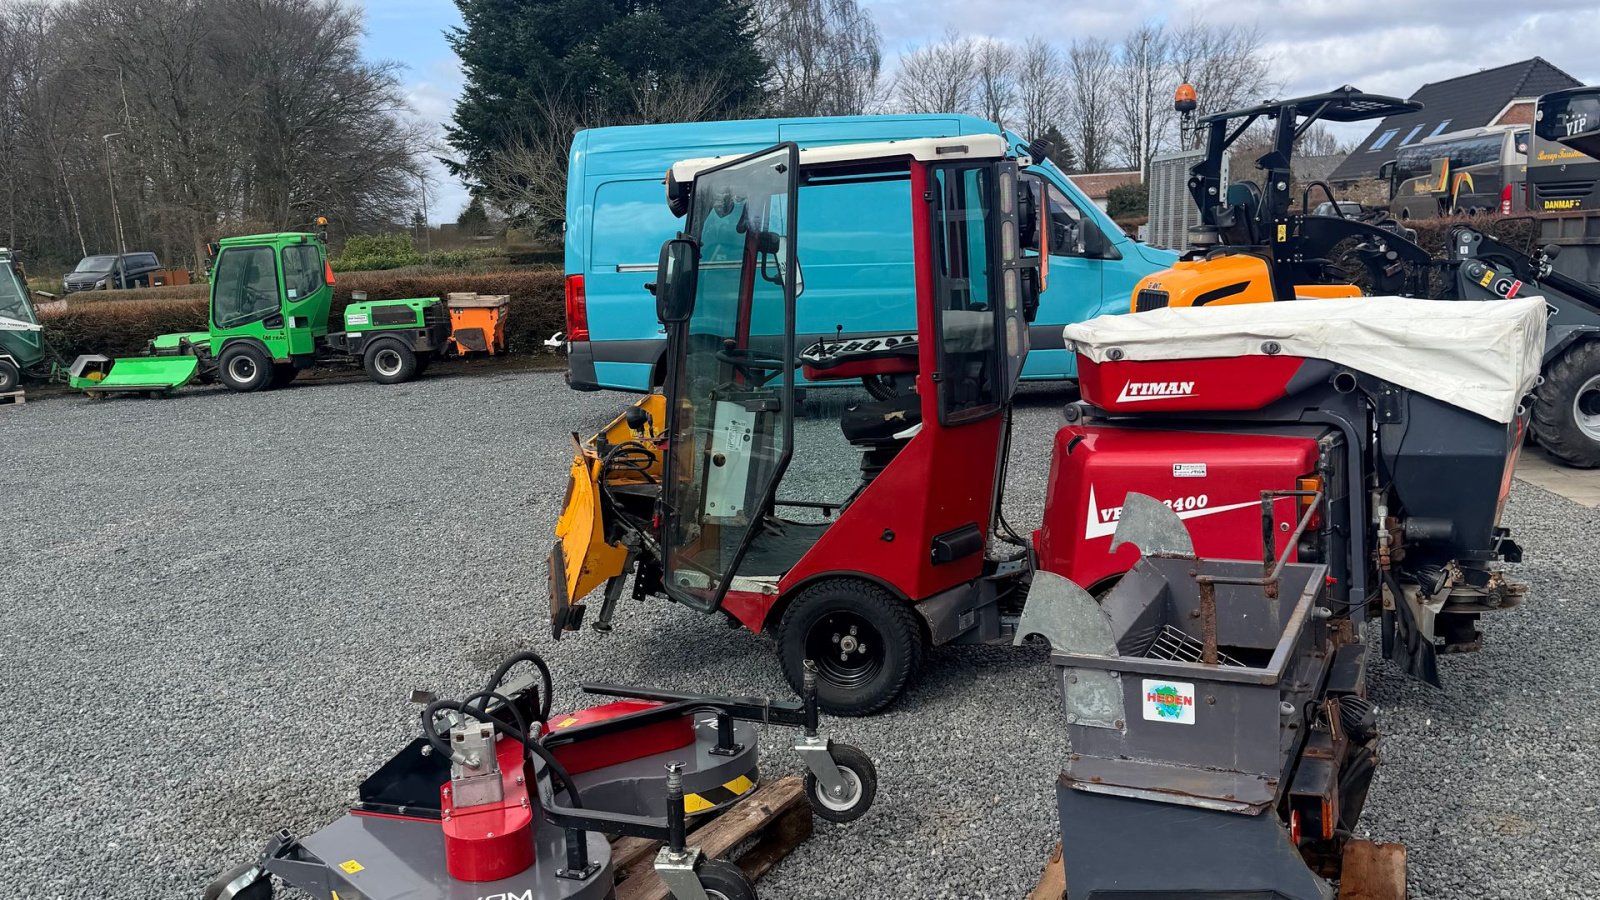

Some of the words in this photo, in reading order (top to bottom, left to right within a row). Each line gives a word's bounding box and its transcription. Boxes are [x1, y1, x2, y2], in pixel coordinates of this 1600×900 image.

[1566, 118, 1587, 136] VIP
[1129, 381, 1195, 396] TIMAN
[1162, 494, 1208, 511] 3400
[1147, 692, 1193, 706] HEDEN
